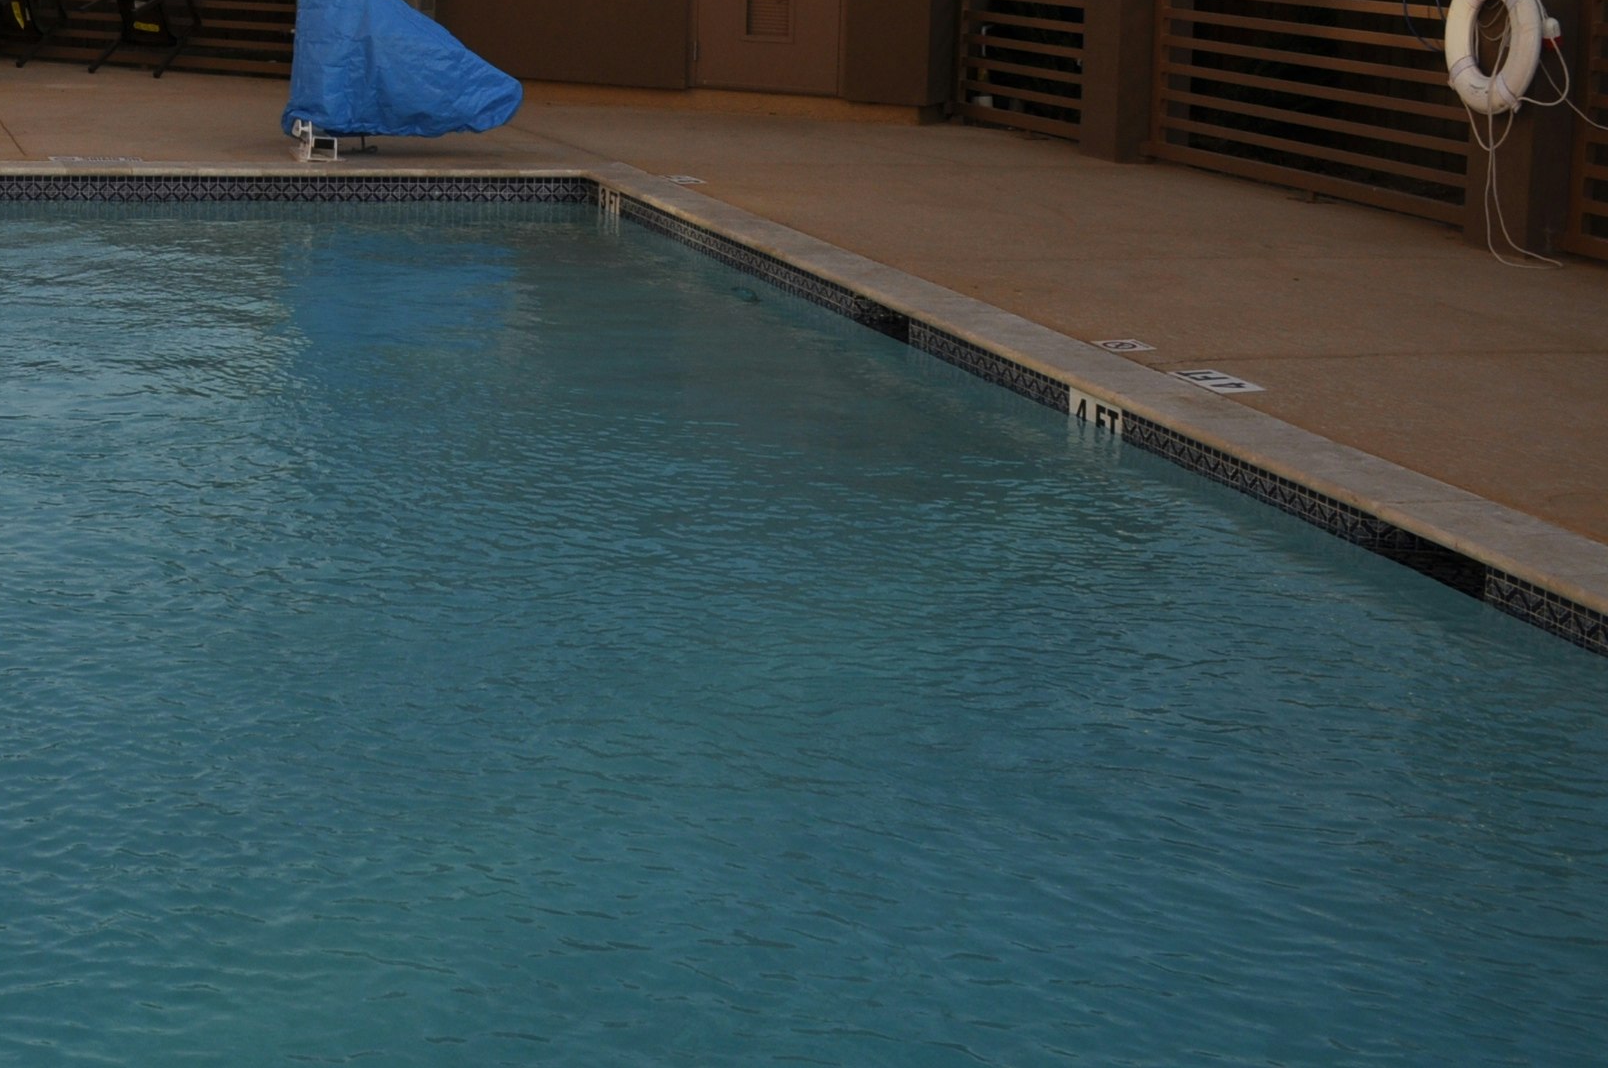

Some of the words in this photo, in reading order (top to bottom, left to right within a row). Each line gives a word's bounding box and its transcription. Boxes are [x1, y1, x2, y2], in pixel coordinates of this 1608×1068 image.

[1176, 370, 1229, 381] FT
[1076, 398, 1087, 422] 4
[1095, 403, 1120, 434] FT
